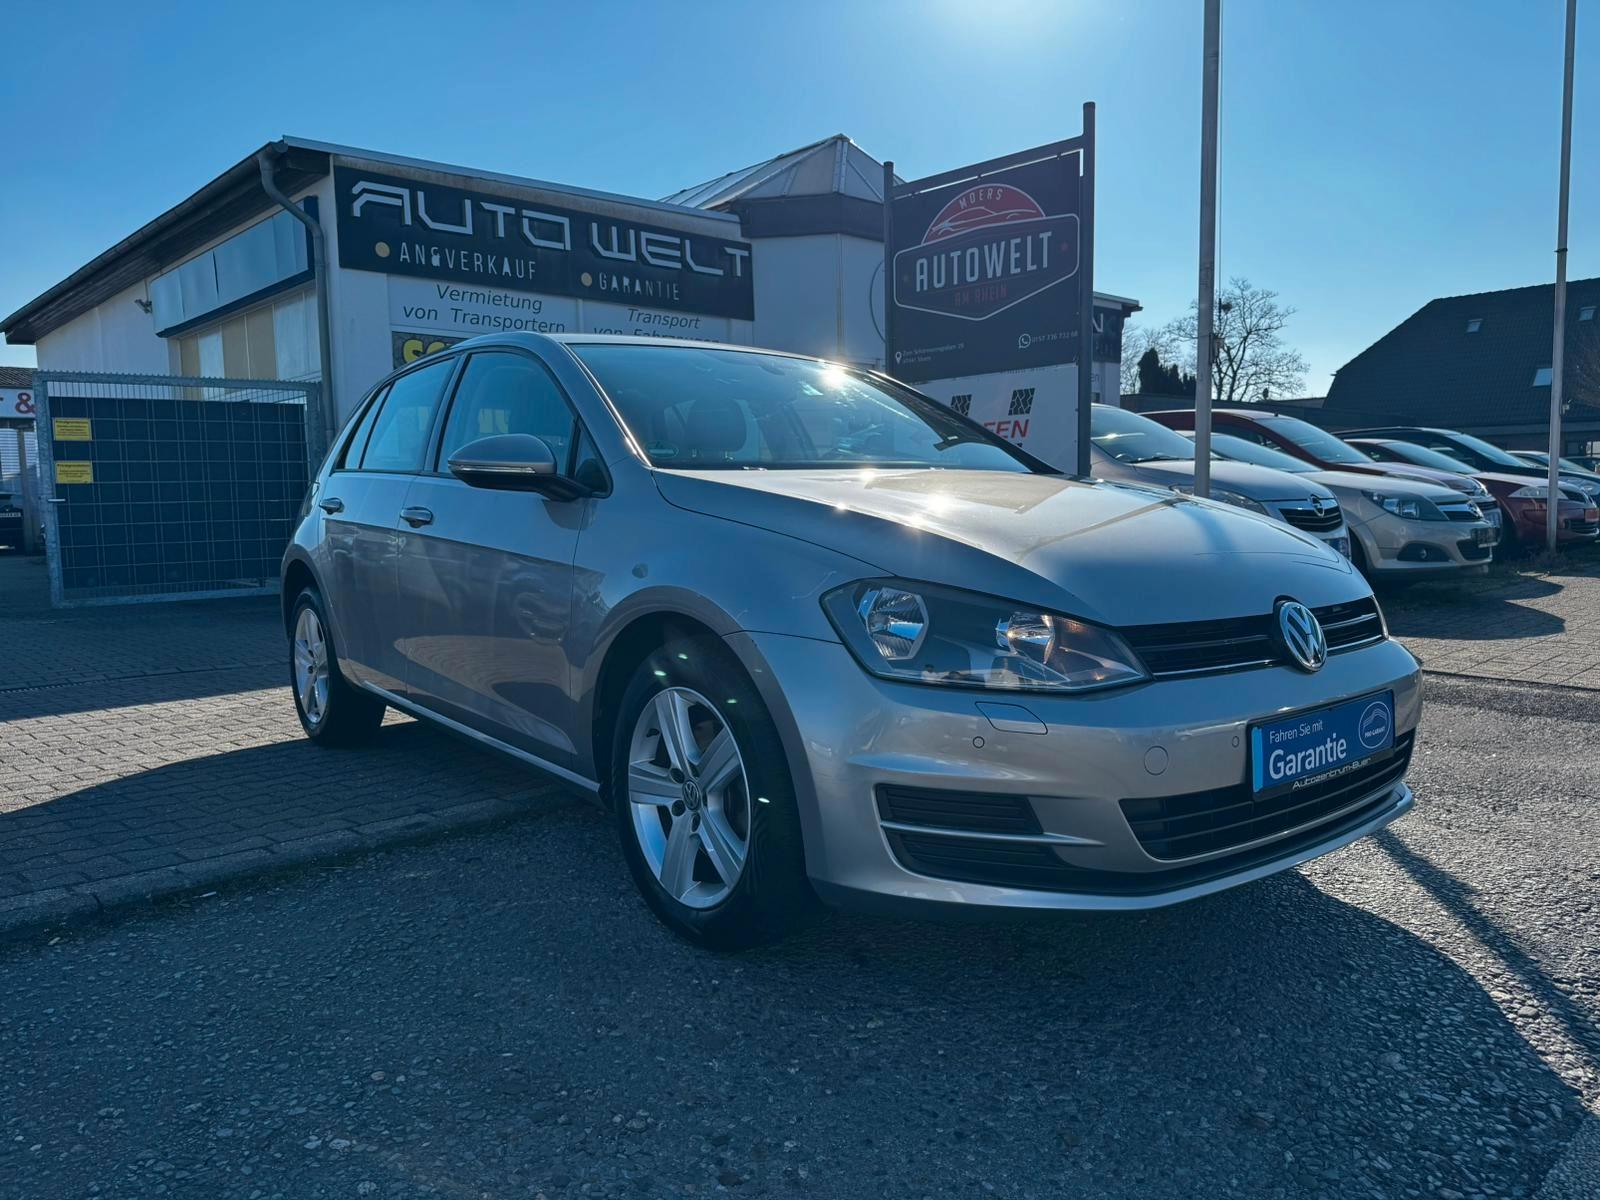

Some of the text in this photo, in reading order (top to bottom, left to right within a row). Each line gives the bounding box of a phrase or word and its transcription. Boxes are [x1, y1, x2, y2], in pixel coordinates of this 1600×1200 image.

[959, 188, 1003, 209] MOERS
[352, 180, 750, 277] AUTO WELT
[916, 231, 1052, 292] AUTOWELT
[436, 283, 542, 314] Vermietung
[600, 271, 680, 300] GARANTIE
[403, 305, 565, 333] von Transportern
[627, 308, 701, 329] Transport
[1269, 719, 1323, 744] Fahren Sie mit
[1268, 732, 1347, 780] Garantie
